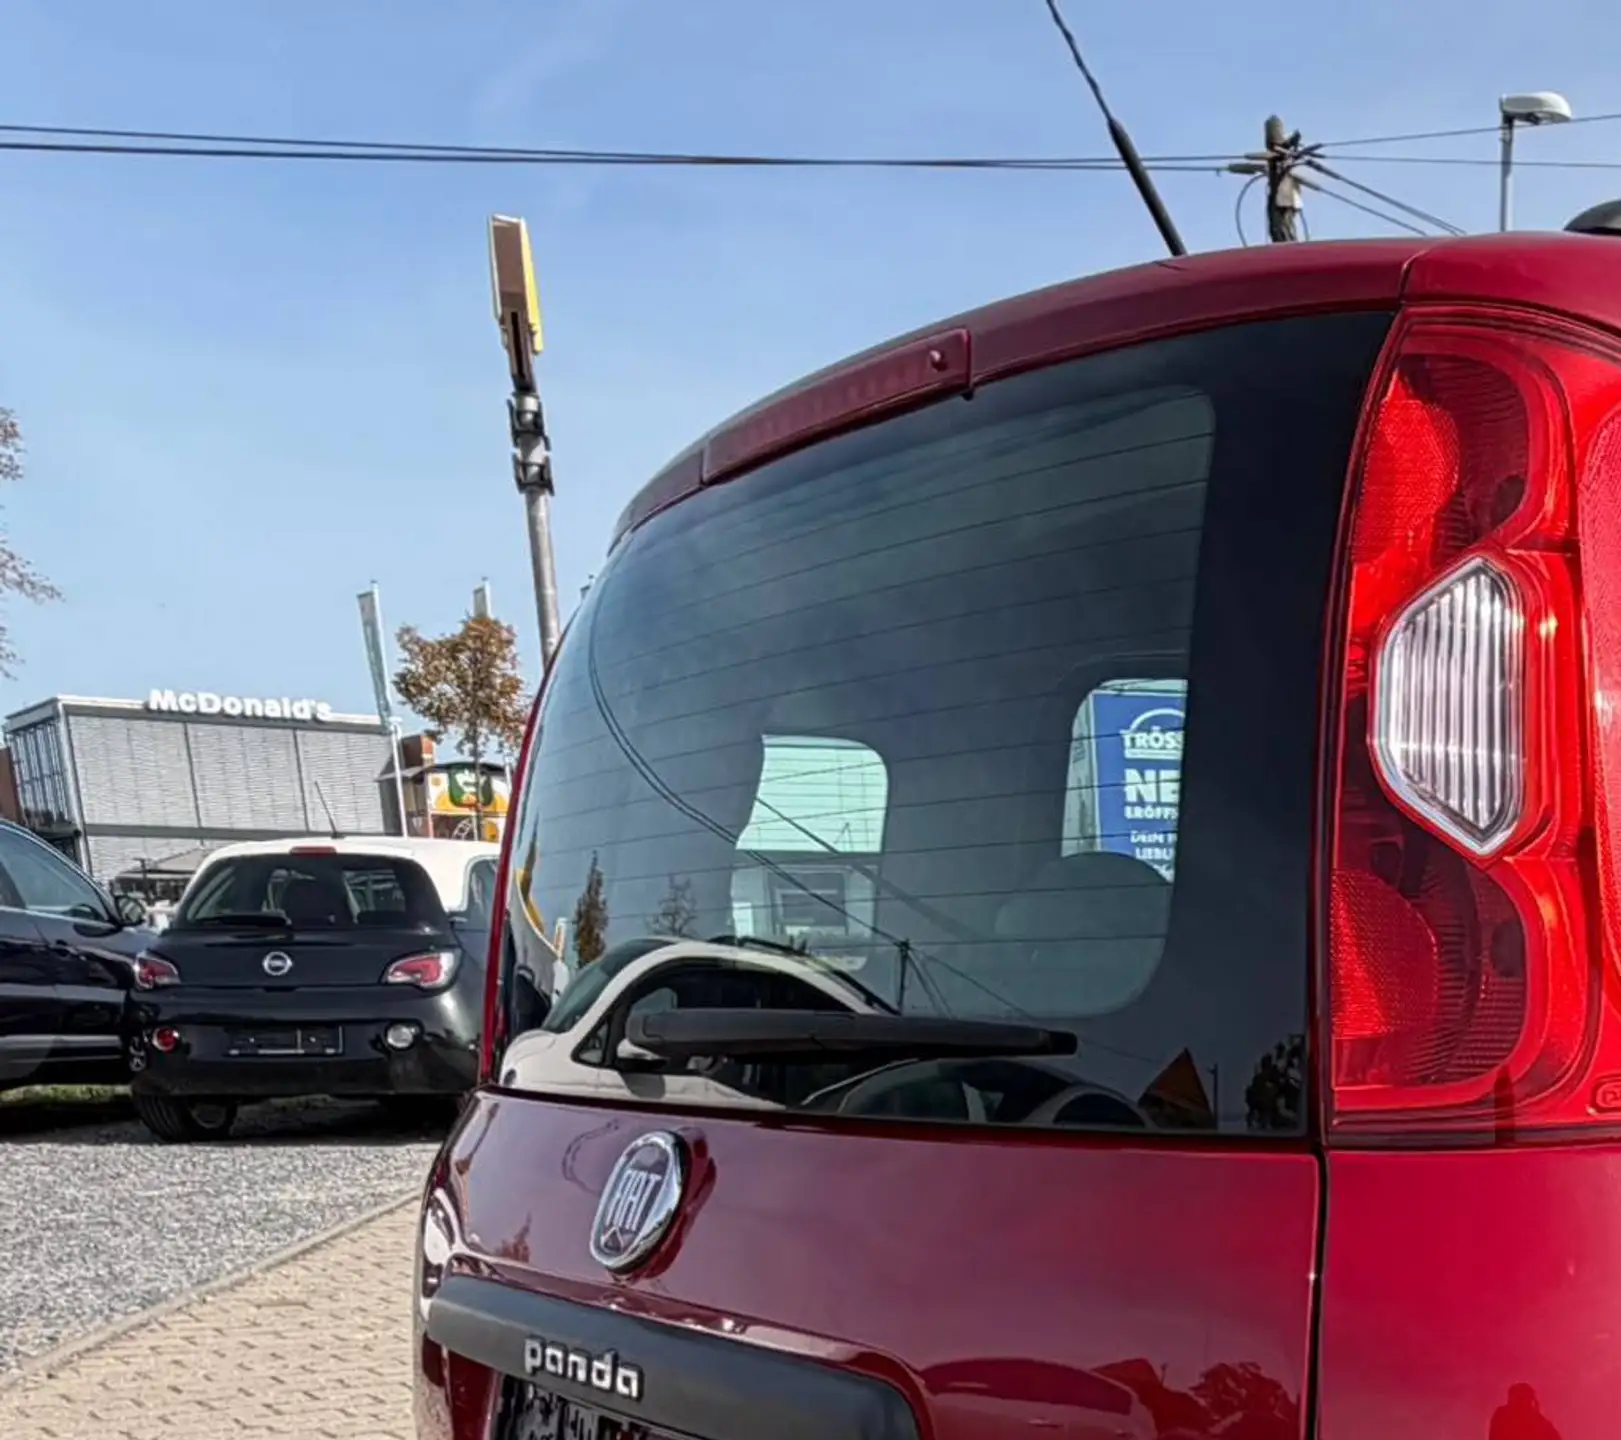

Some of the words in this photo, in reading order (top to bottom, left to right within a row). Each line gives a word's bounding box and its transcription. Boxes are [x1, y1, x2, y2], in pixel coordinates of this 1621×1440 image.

[149, 687, 332, 722] McDonald's
[606, 1169, 662, 1232] FIAT
[524, 1338, 640, 1399] panda
